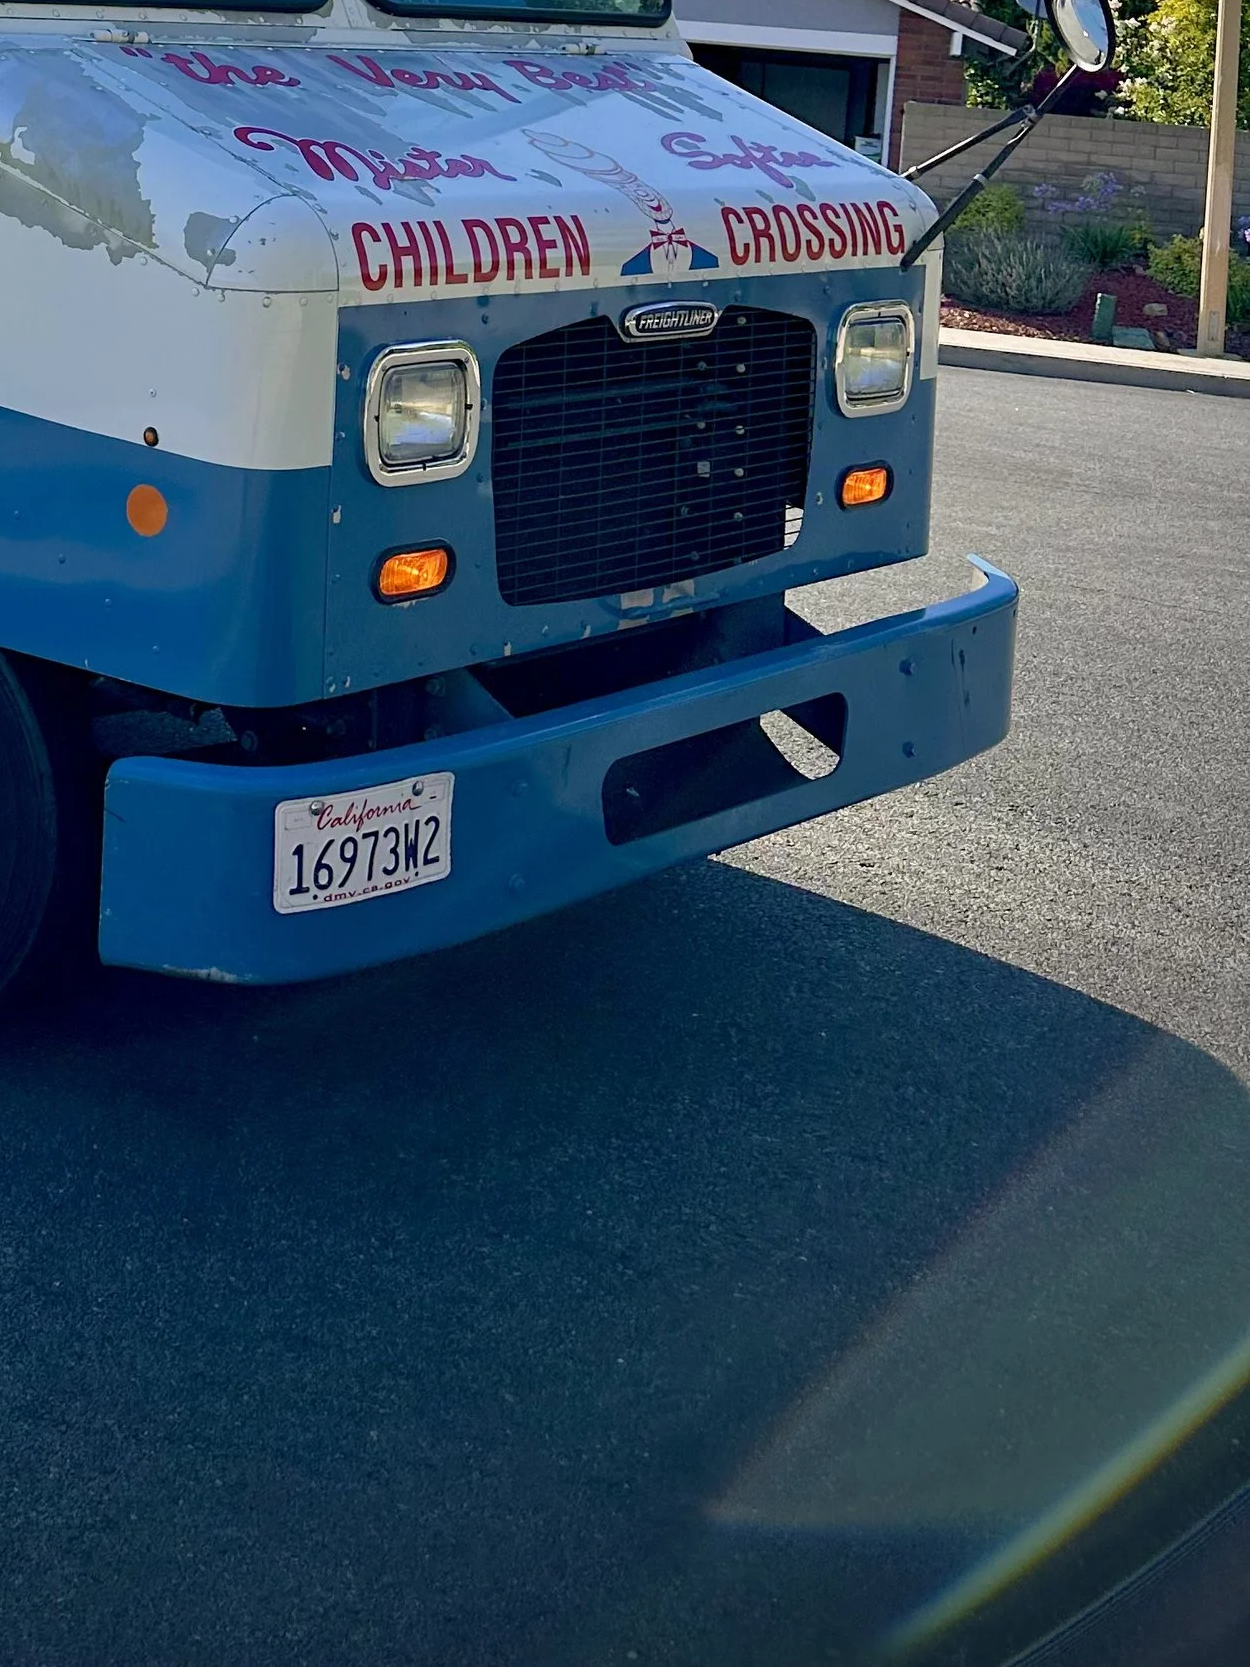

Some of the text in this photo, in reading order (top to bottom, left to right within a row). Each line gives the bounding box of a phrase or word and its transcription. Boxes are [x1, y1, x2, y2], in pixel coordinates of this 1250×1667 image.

[327, 54, 522, 104] Very
[234, 126, 839, 190] Mister Softee
[350, 200, 906, 291] CHILDREN CROSSING
[638, 309, 713, 330] FREIGHTLINER
[317, 798, 423, 833] California
[289, 815, 441, 896] 16973W2
[324, 876, 411, 902] dmv.ca.gov
